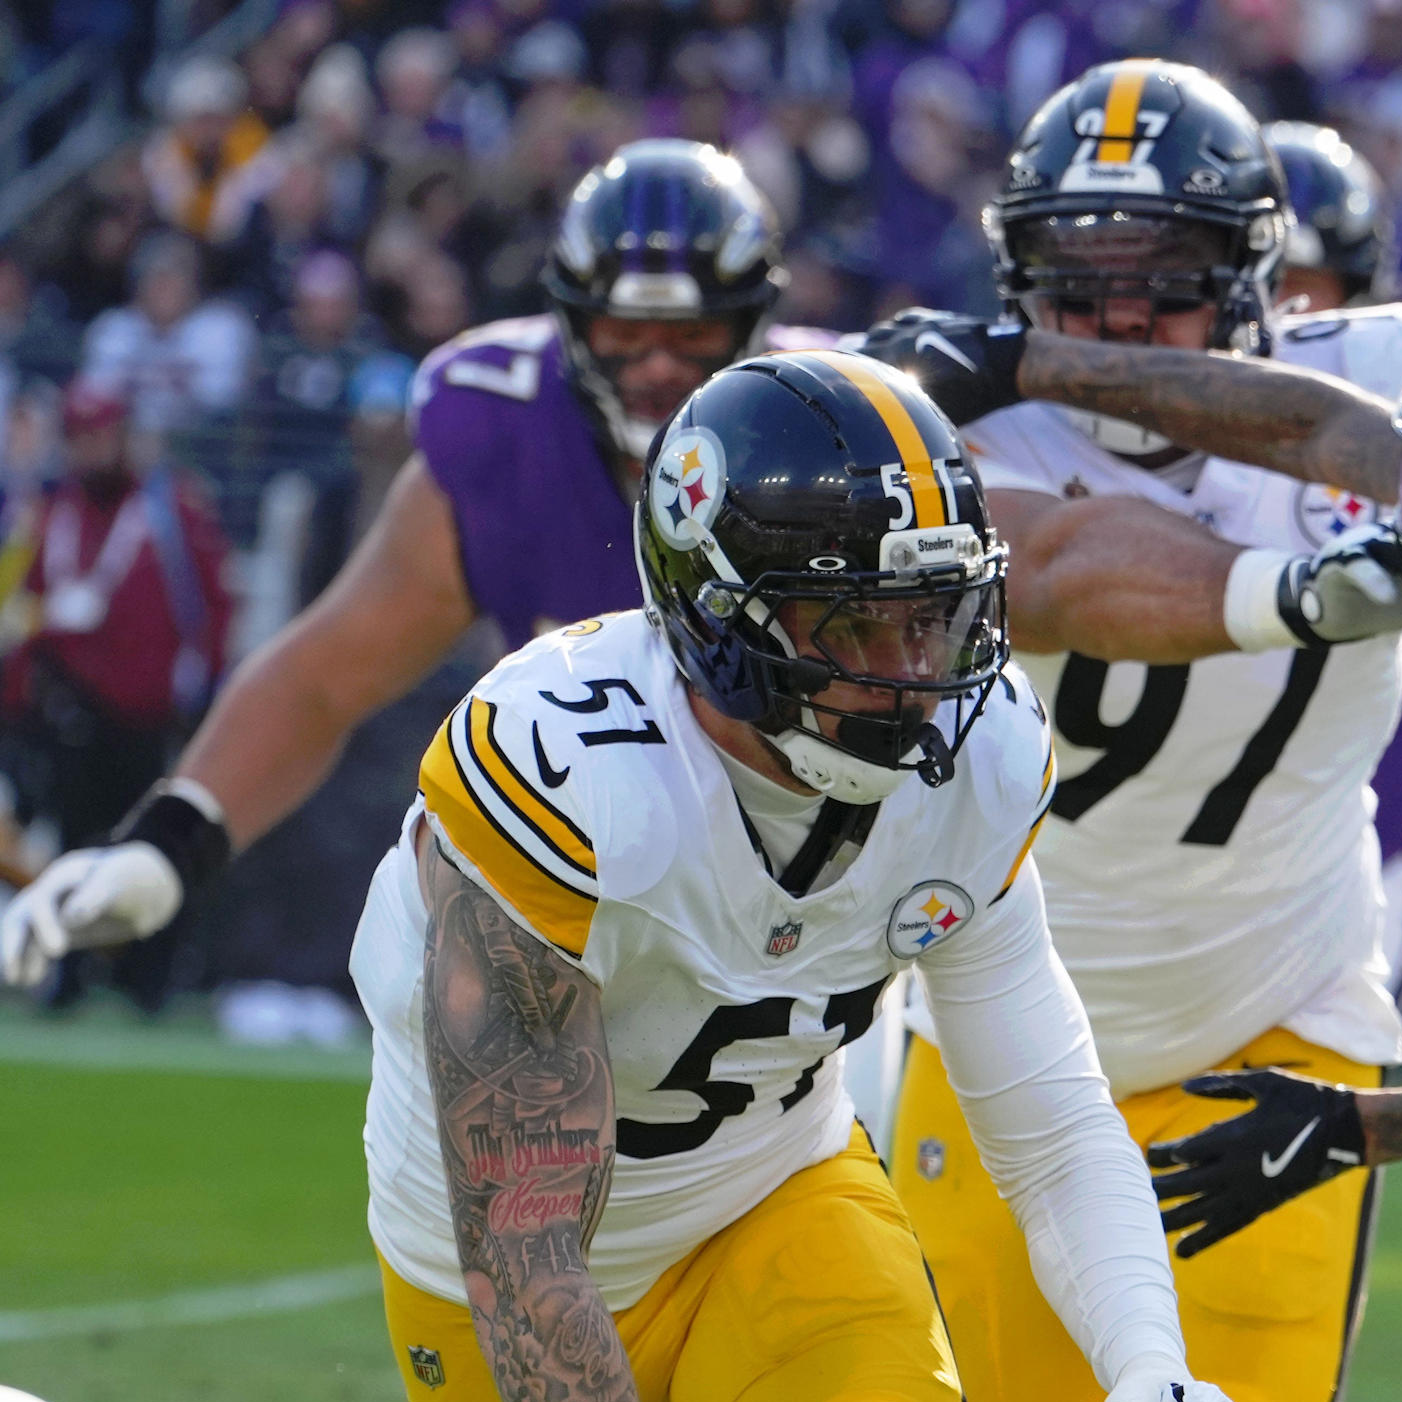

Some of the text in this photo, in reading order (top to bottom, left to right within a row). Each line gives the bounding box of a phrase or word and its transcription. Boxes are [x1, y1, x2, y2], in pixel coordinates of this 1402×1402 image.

[880, 458, 959, 531] 51
[918, 536, 954, 553] Steelers
[538, 679, 668, 747] 51
[897, 921, 930, 932] Steelers
